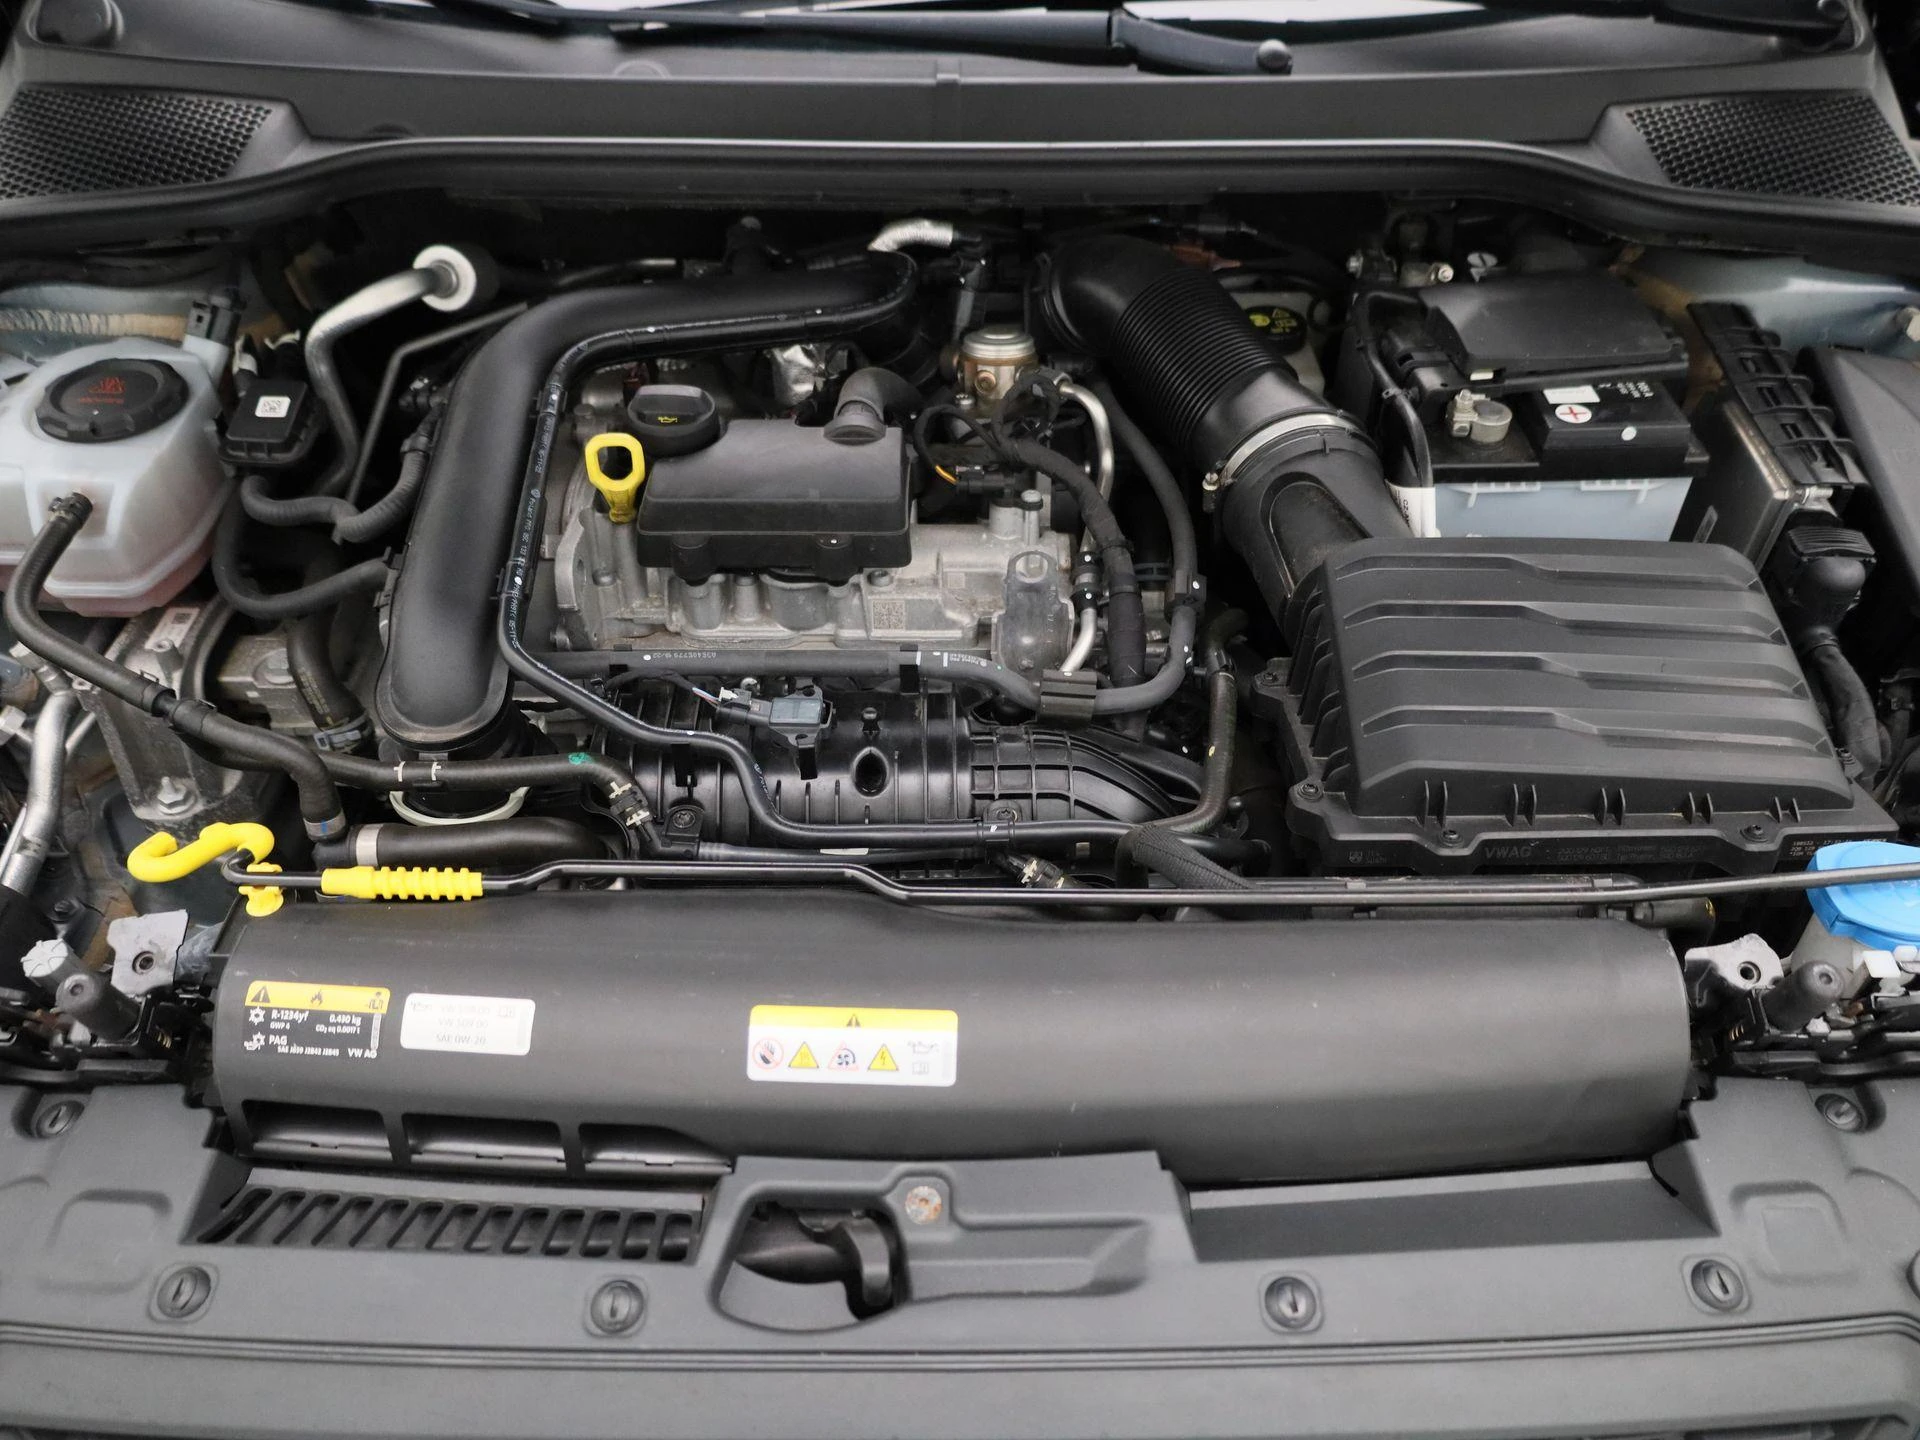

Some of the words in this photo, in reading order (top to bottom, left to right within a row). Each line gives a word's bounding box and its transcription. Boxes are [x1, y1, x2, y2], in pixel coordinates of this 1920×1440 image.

[271, 1009, 309, 1024] R-1234yf
[351, 1014, 362, 1026] kg
[270, 1021, 285, 1030] GWP
[269, 1034, 288, 1045] PAG
[277, 1045, 289, 1054] SAE
[347, 1047, 363, 1058] VW
[363, 1049, 377, 1059] AG
